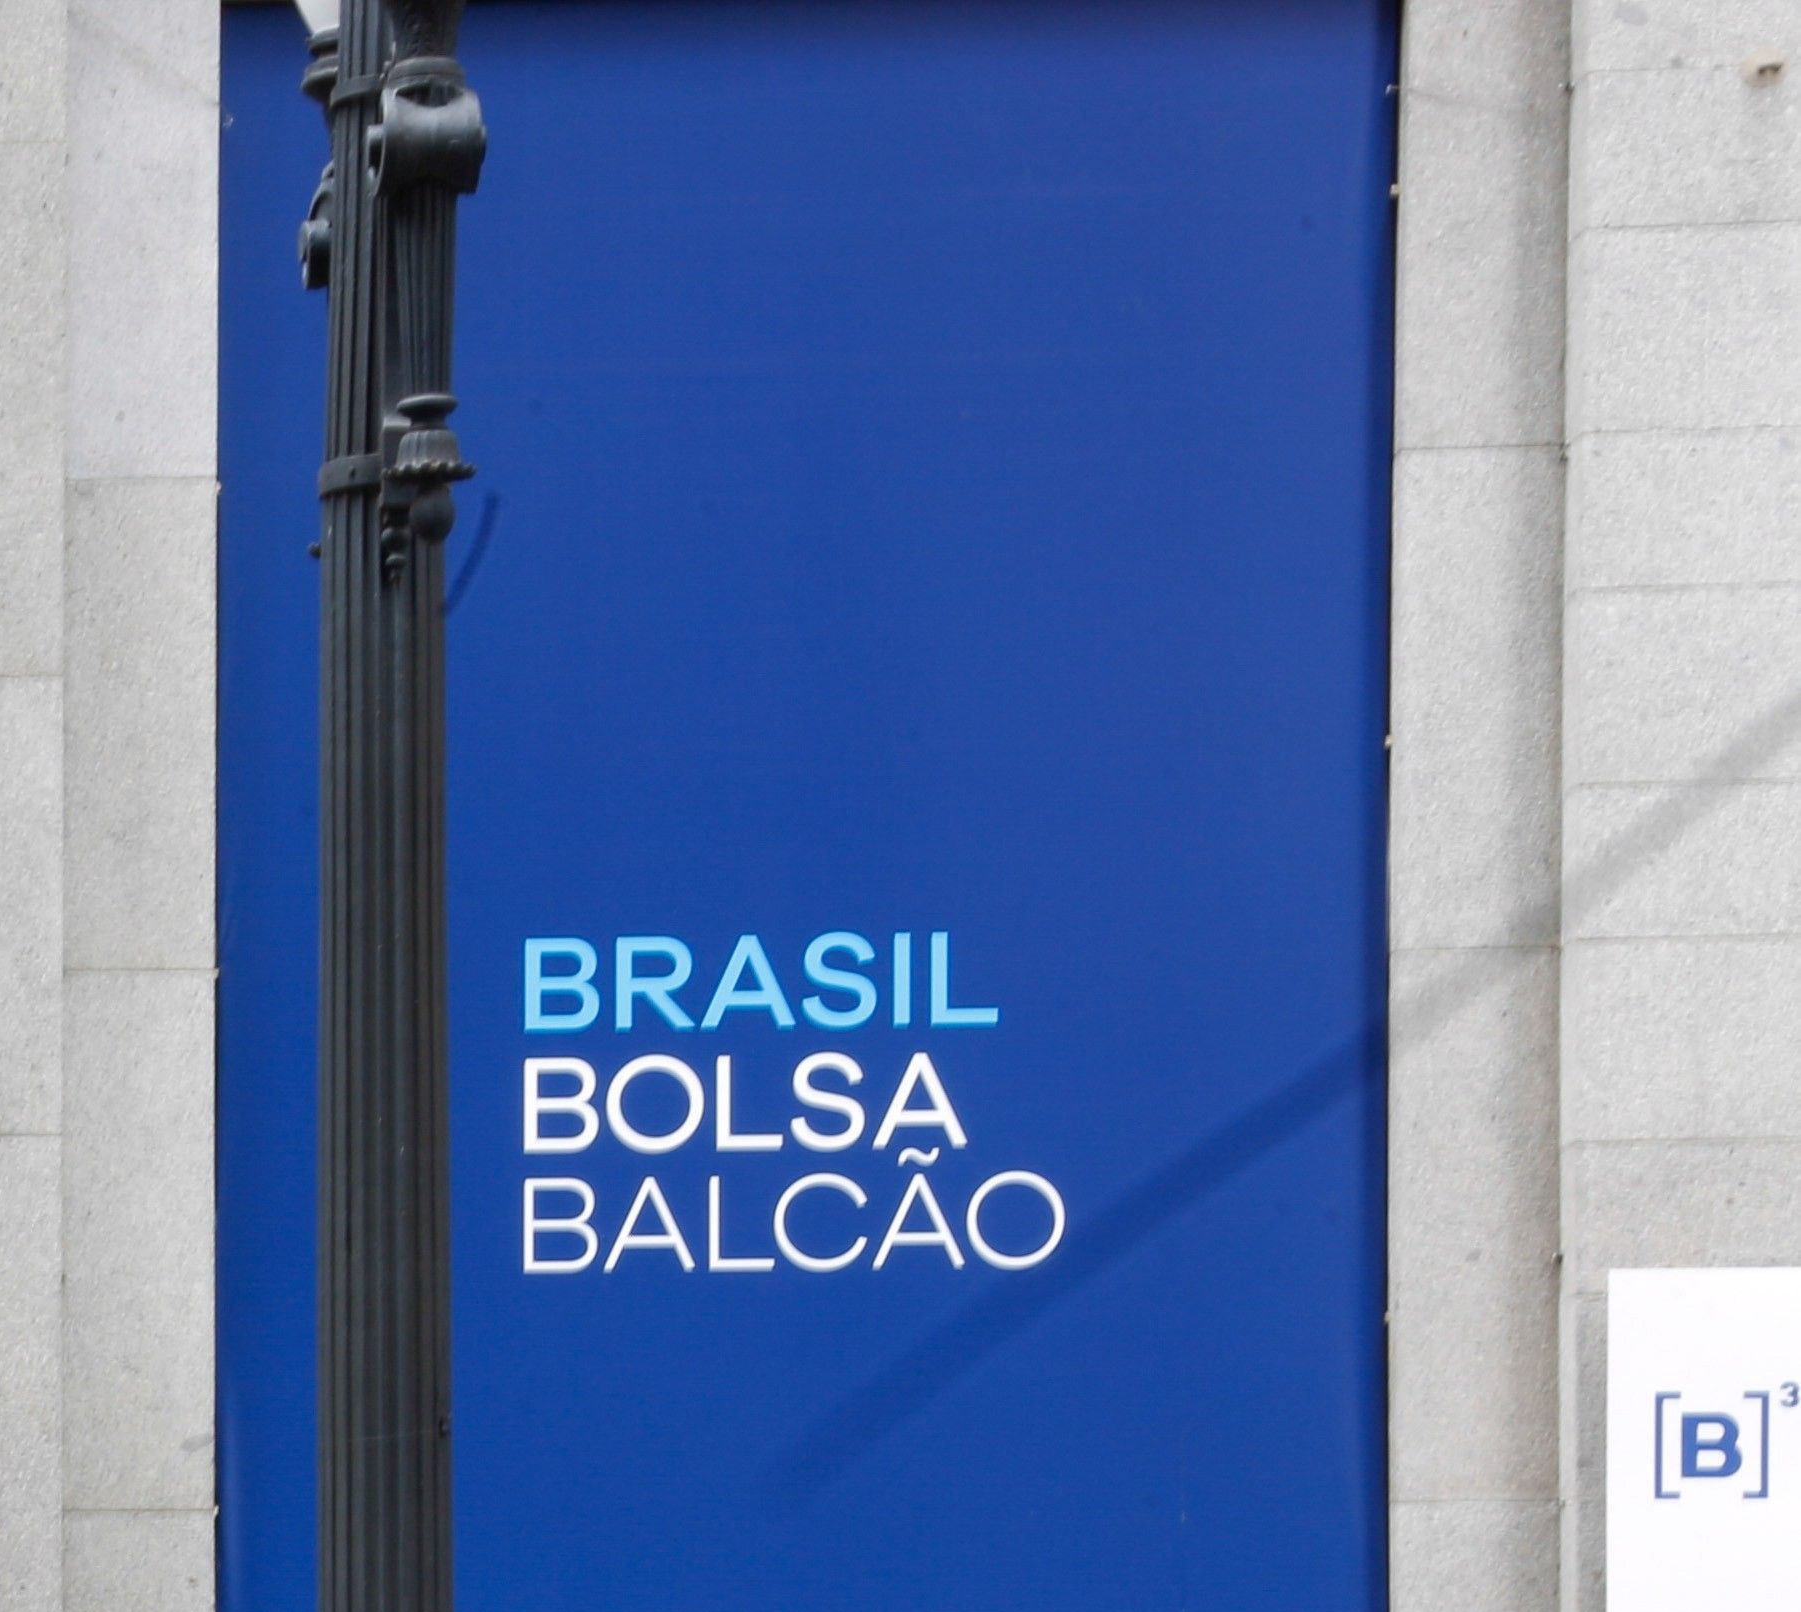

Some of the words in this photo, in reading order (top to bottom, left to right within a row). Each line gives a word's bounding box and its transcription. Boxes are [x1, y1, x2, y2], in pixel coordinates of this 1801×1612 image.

[523, 932, 998, 1033] BRASIL
[522, 1052, 967, 1154] BOLSA
[522, 1147, 1066, 1274] BALCÃO
